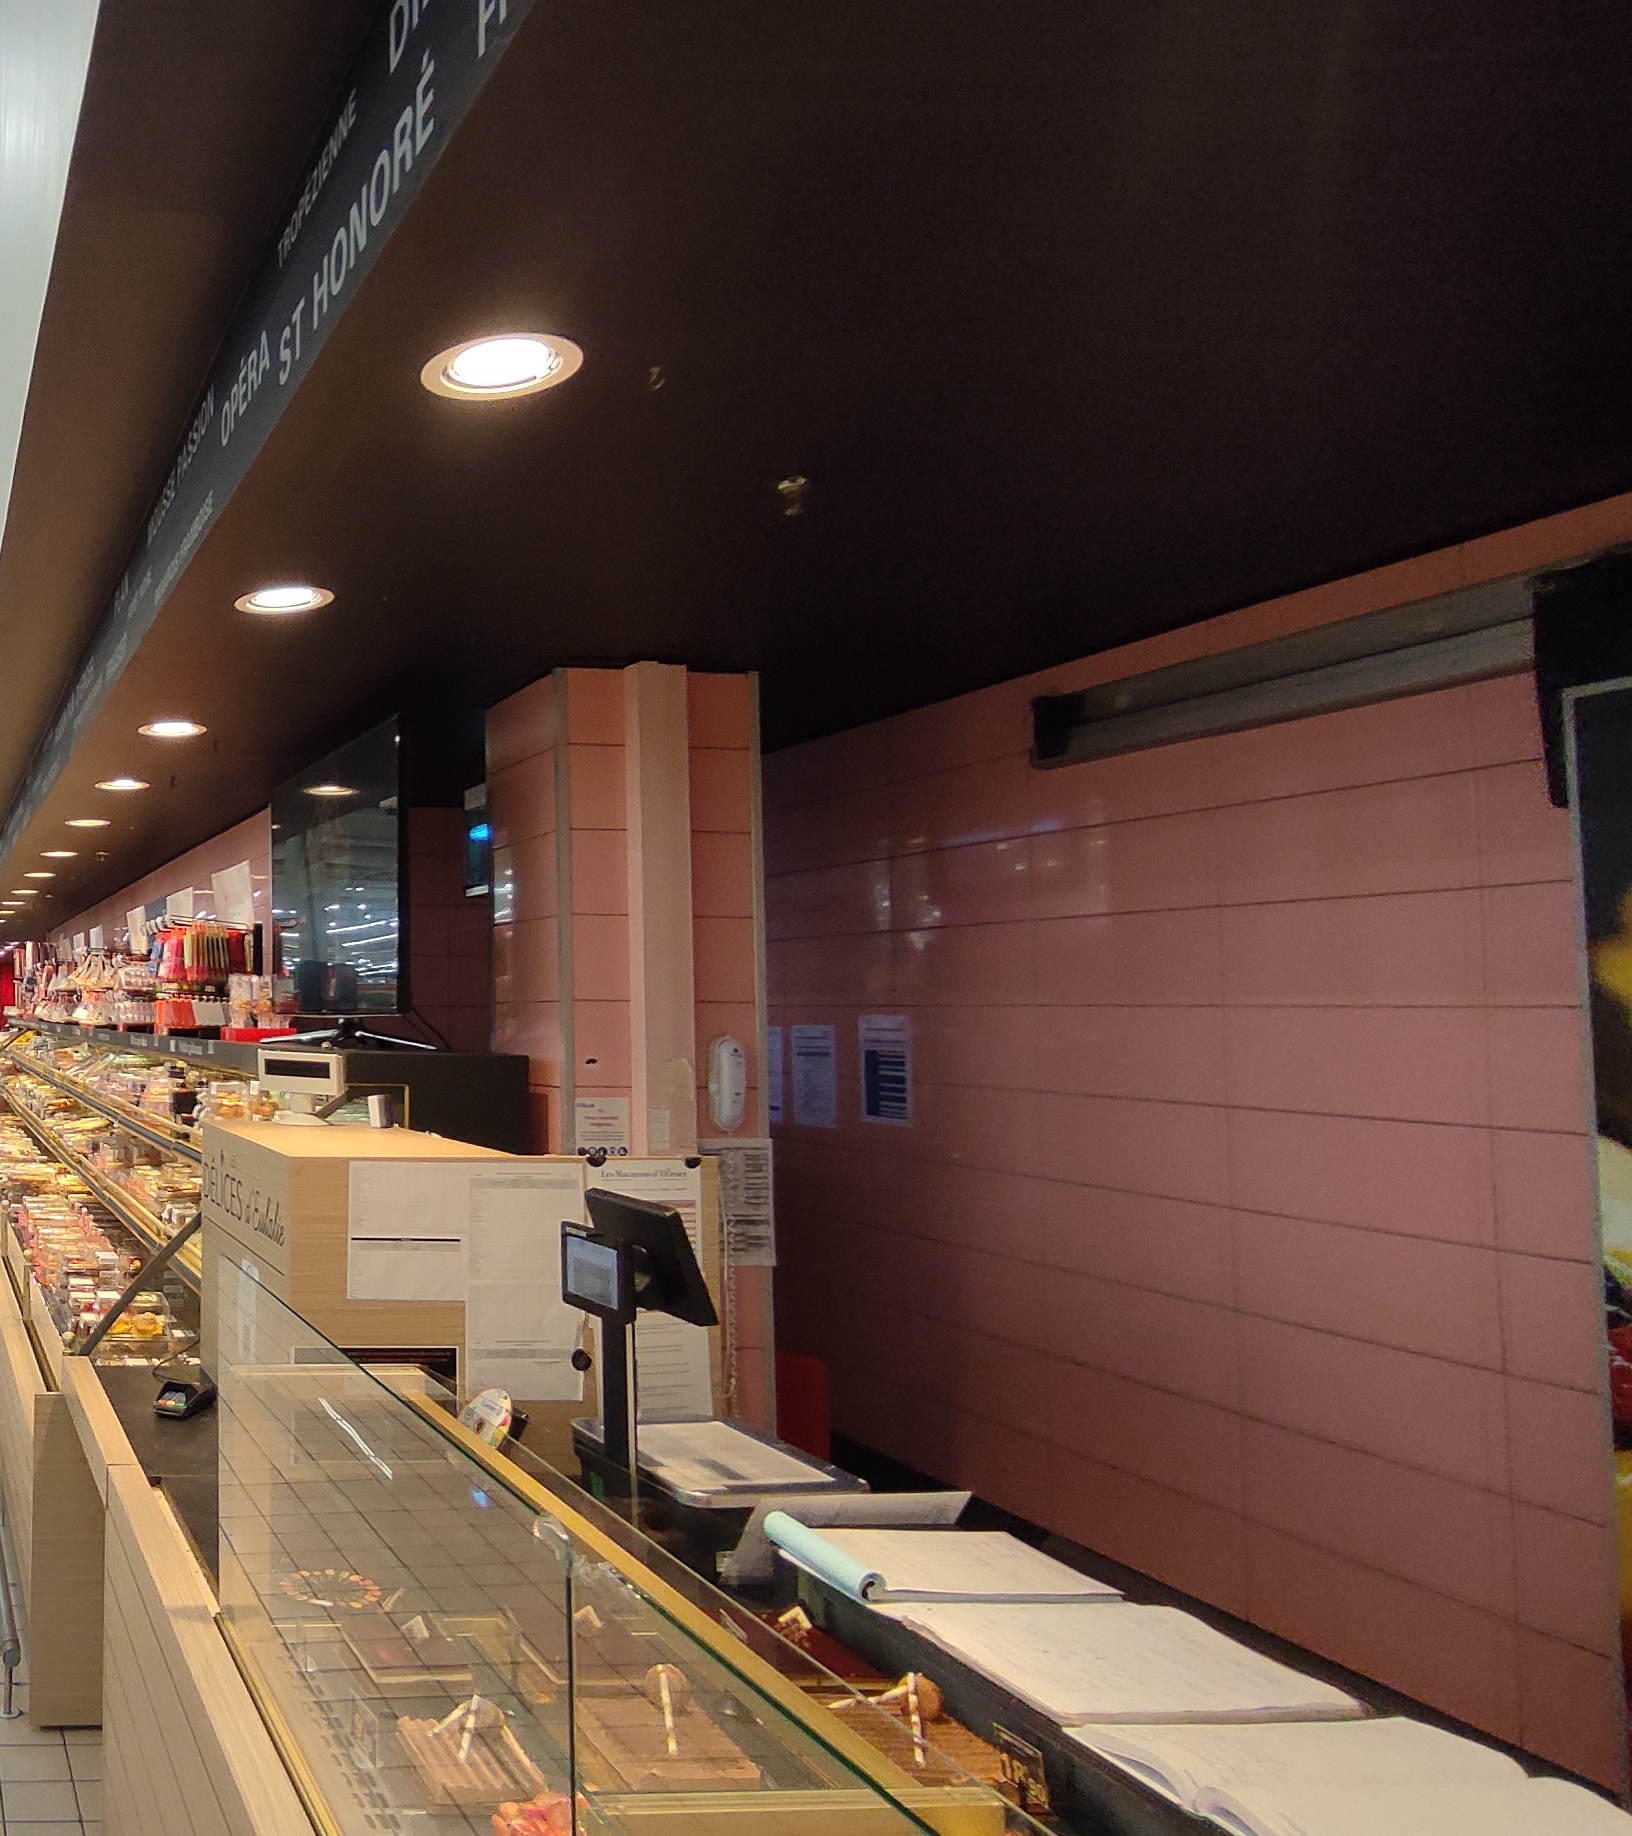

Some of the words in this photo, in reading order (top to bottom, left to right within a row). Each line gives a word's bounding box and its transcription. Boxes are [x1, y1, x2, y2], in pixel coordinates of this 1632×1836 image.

[277, 297, 306, 388] ST
[312, 46, 436, 333] HONORÉ
[219, 329, 271, 447] OPÉRA
[203, 1157, 243, 1221] DÉLICES
